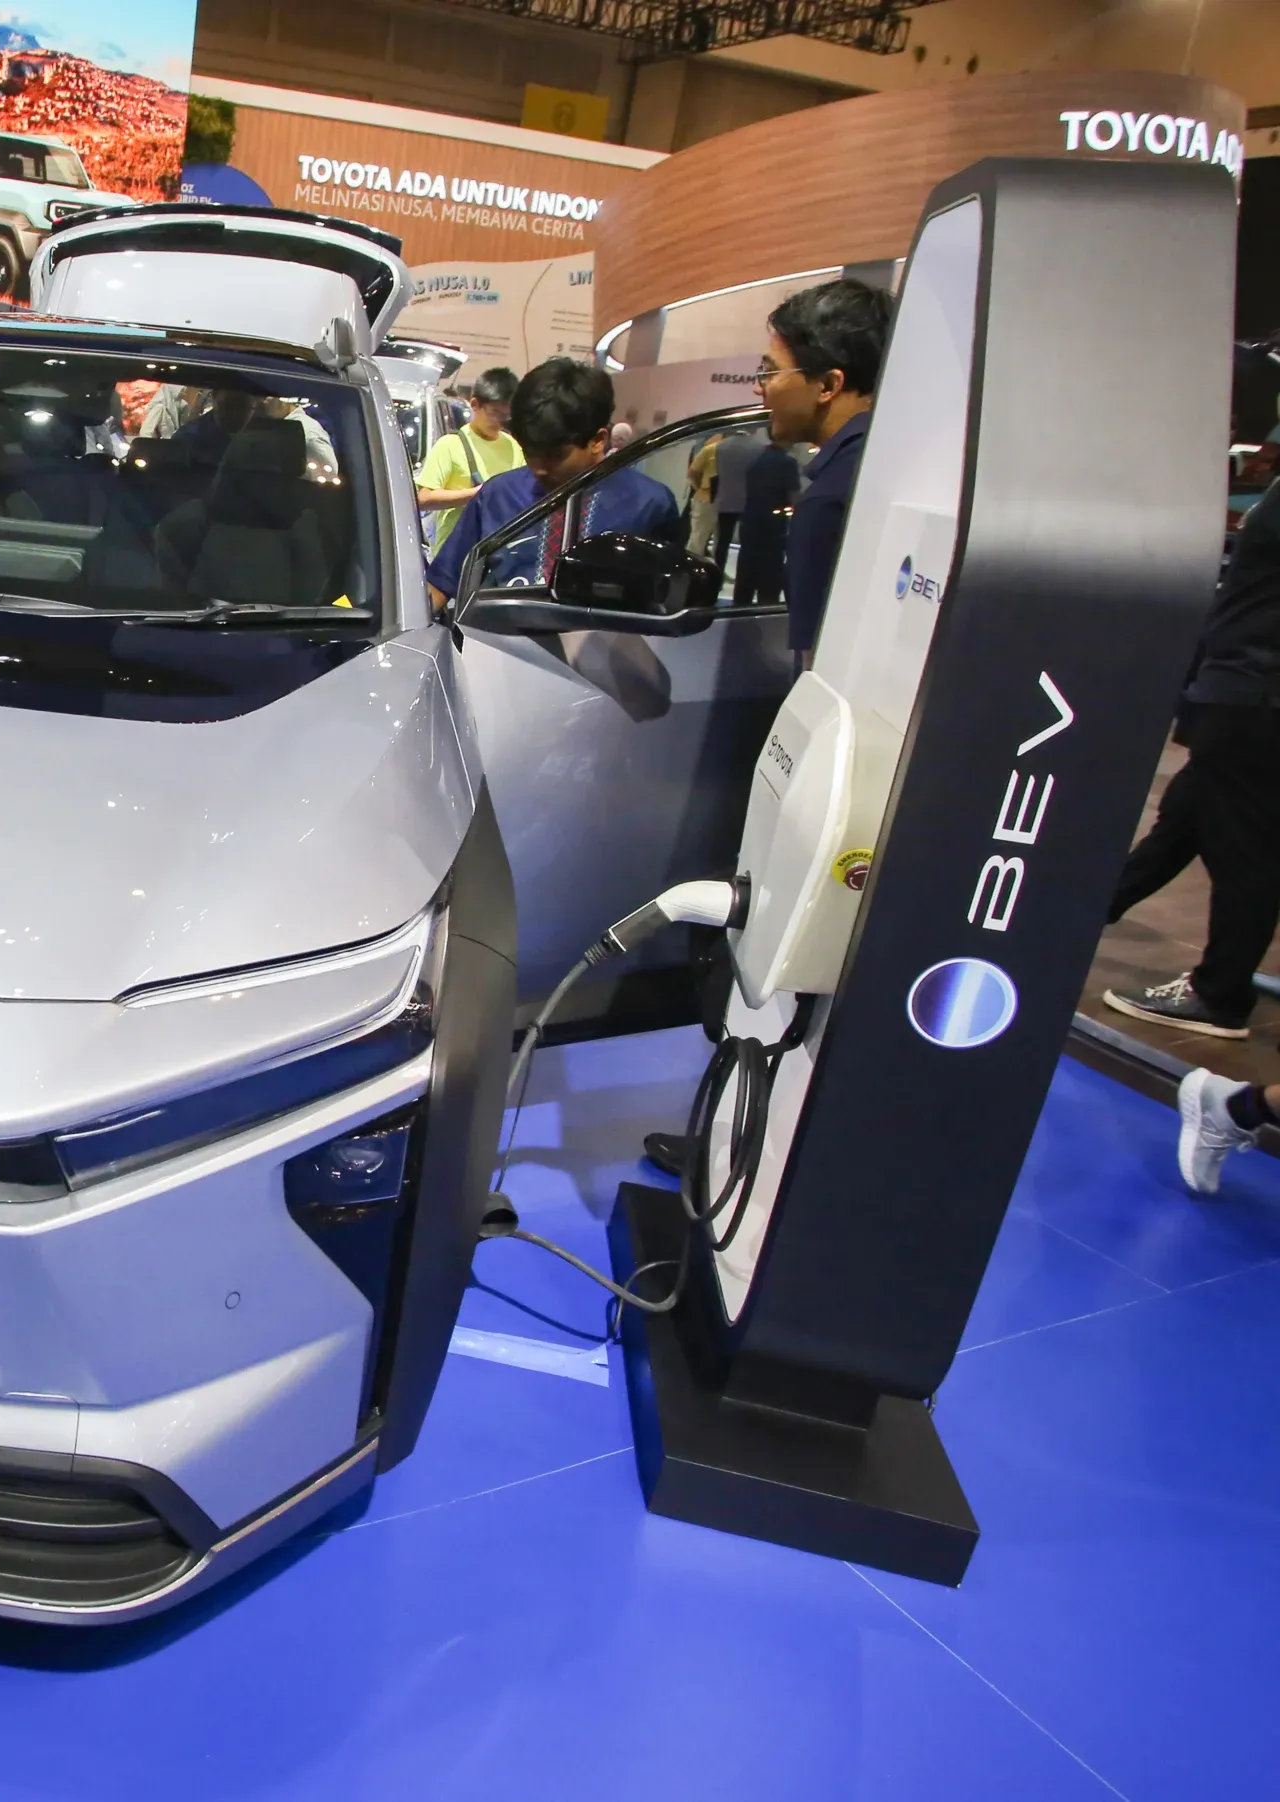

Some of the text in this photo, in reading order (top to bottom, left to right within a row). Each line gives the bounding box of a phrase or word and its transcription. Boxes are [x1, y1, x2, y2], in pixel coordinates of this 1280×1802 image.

[1059, 110, 1210, 162] TOYOTA
[298, 154, 392, 192] TOYOTA
[394, 169, 446, 200] ADA
[450, 177, 529, 212] UNTUK
[294, 183, 585, 241] MELINTASI NUSA, MEMBAWA CERITA
[428, 275, 468, 292] NUSA
[472, 275, 491, 291] 1.0
[773, 744, 795, 778] TOYOTA
[967, 670, 1074, 932] BEV
